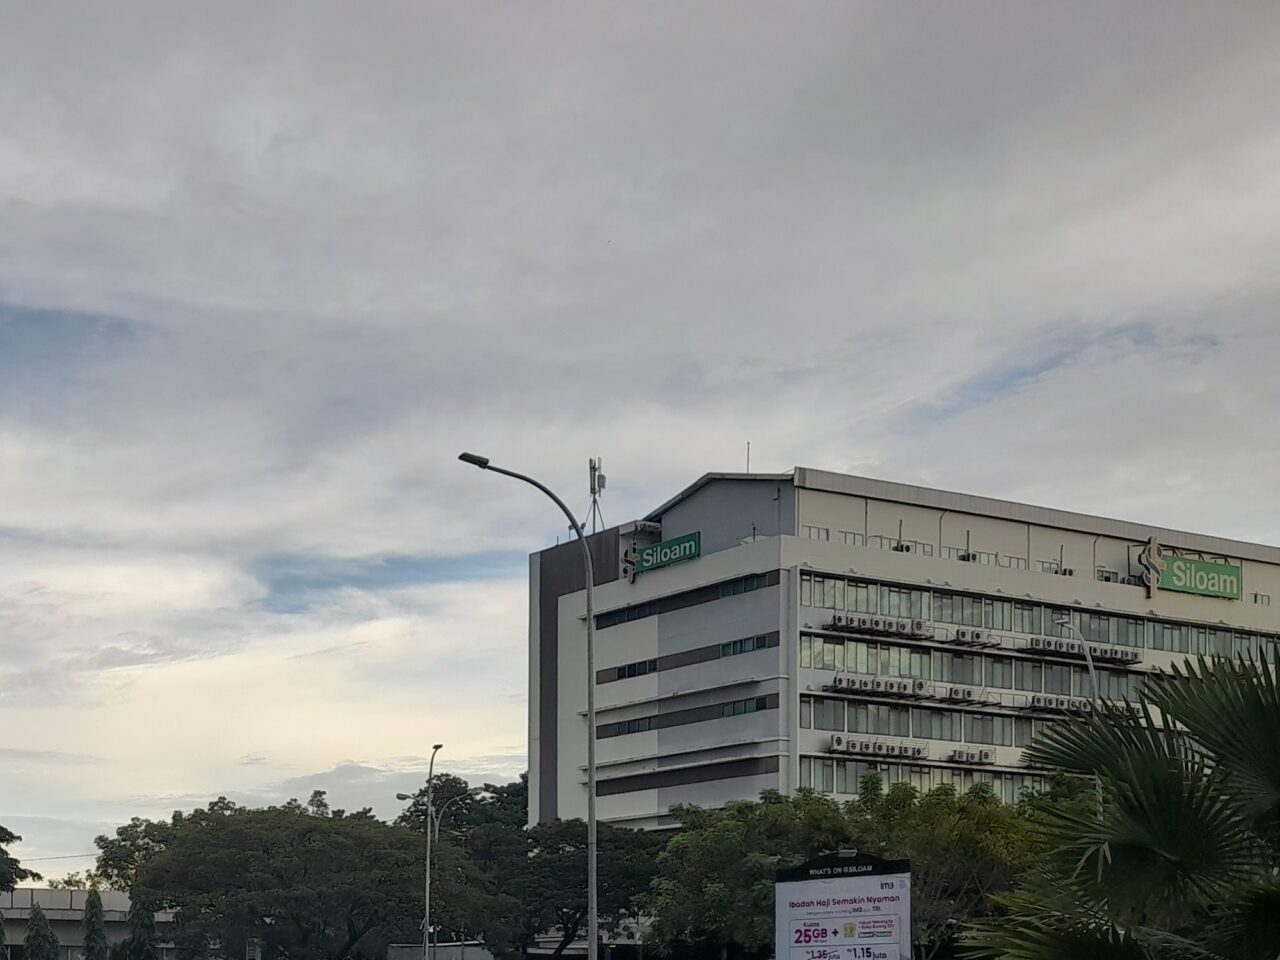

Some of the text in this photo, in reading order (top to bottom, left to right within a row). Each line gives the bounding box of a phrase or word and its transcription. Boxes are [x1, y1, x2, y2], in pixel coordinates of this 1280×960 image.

[642, 540, 696, 567] Siloam
[1172, 560, 1238, 594] Siloam
[816, 899, 831, 908] Haji
[832, 896, 866, 906] Semakin
[866, 895, 901, 904] Nyaman
[872, 951, 888, 960] juta
